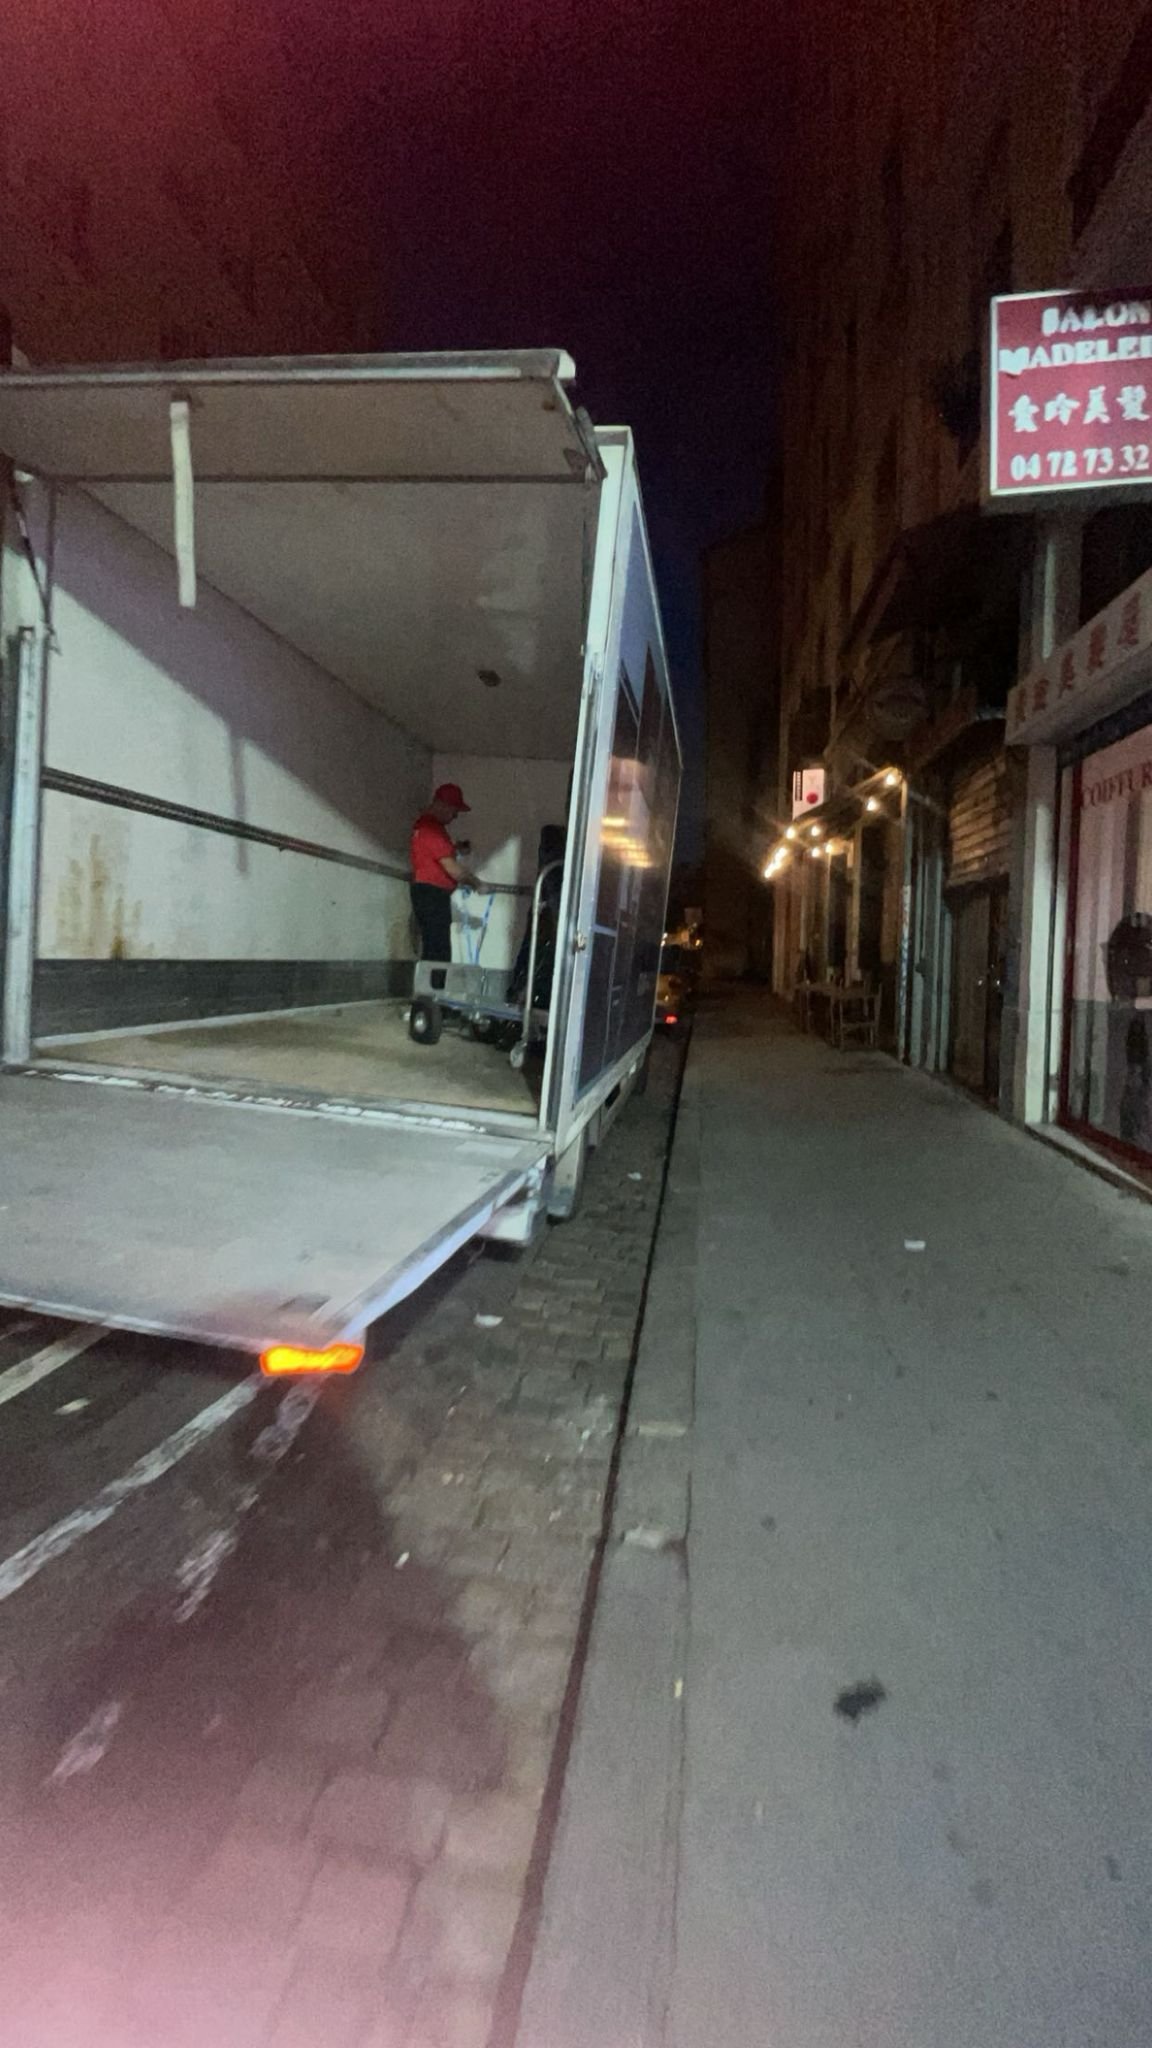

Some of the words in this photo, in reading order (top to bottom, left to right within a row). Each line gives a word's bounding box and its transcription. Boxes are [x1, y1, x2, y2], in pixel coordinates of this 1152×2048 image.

[1010, 454, 1041, 481] 04
[1047, 450, 1078, 477] 72
[1083, 447, 1114, 474] 73
[1119, 444, 1150, 472] 32
